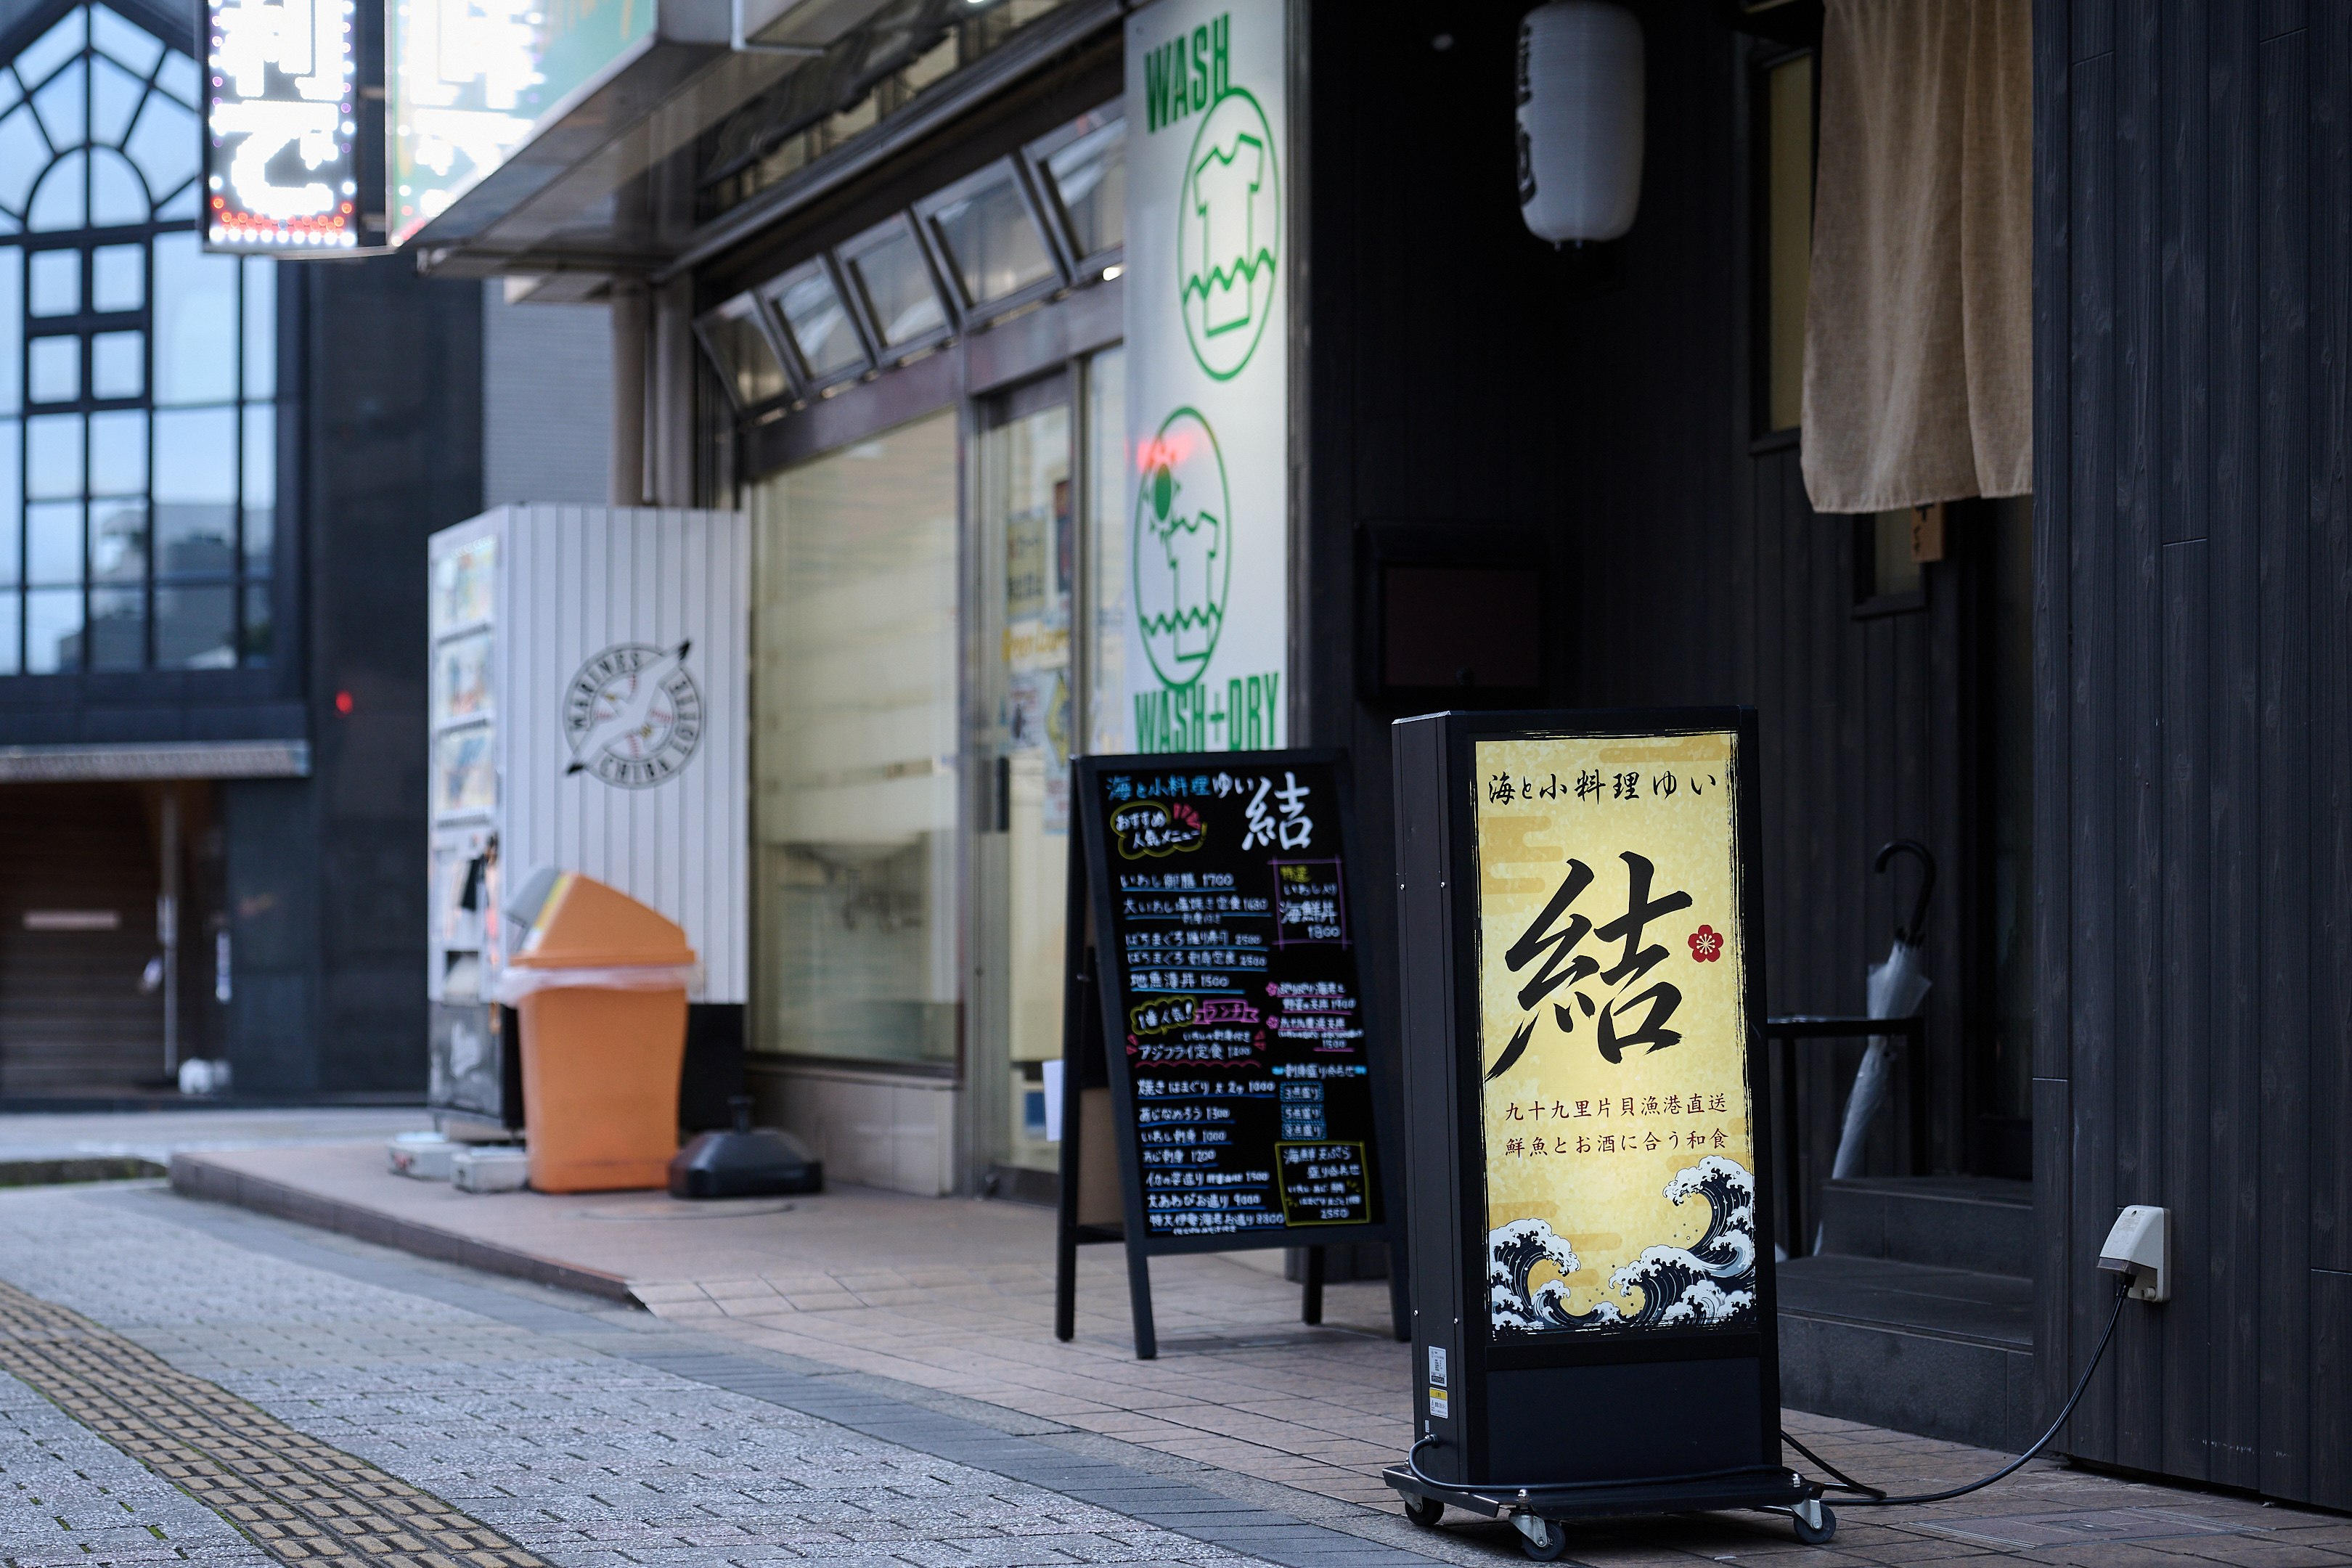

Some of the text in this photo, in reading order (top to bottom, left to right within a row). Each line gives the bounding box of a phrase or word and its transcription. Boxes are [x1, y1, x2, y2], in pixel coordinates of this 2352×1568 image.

[1144, 10, 1230, 135] WASH
[1134, 669, 1280, 755] WASH+DRY
[1107, 772, 1254, 800] 海と小料理ゆい
[1488, 769, 1716, 806] 海と小料理ゆい
[1116, 812, 1167, 833] おすすめ
[1241, 771, 1313, 851] 結
[1133, 829, 1200, 849] 人気メニュー
[1202, 874, 1233, 886] 1700
[1201, 975, 1228, 987] 1500
[1483, 851, 1693, 1084] 結
[1506, 1093, 1726, 1121] 九十九里片貝漁港直送
[1505, 1127, 1729, 1161] 鮮魚とお酒に合う和食
